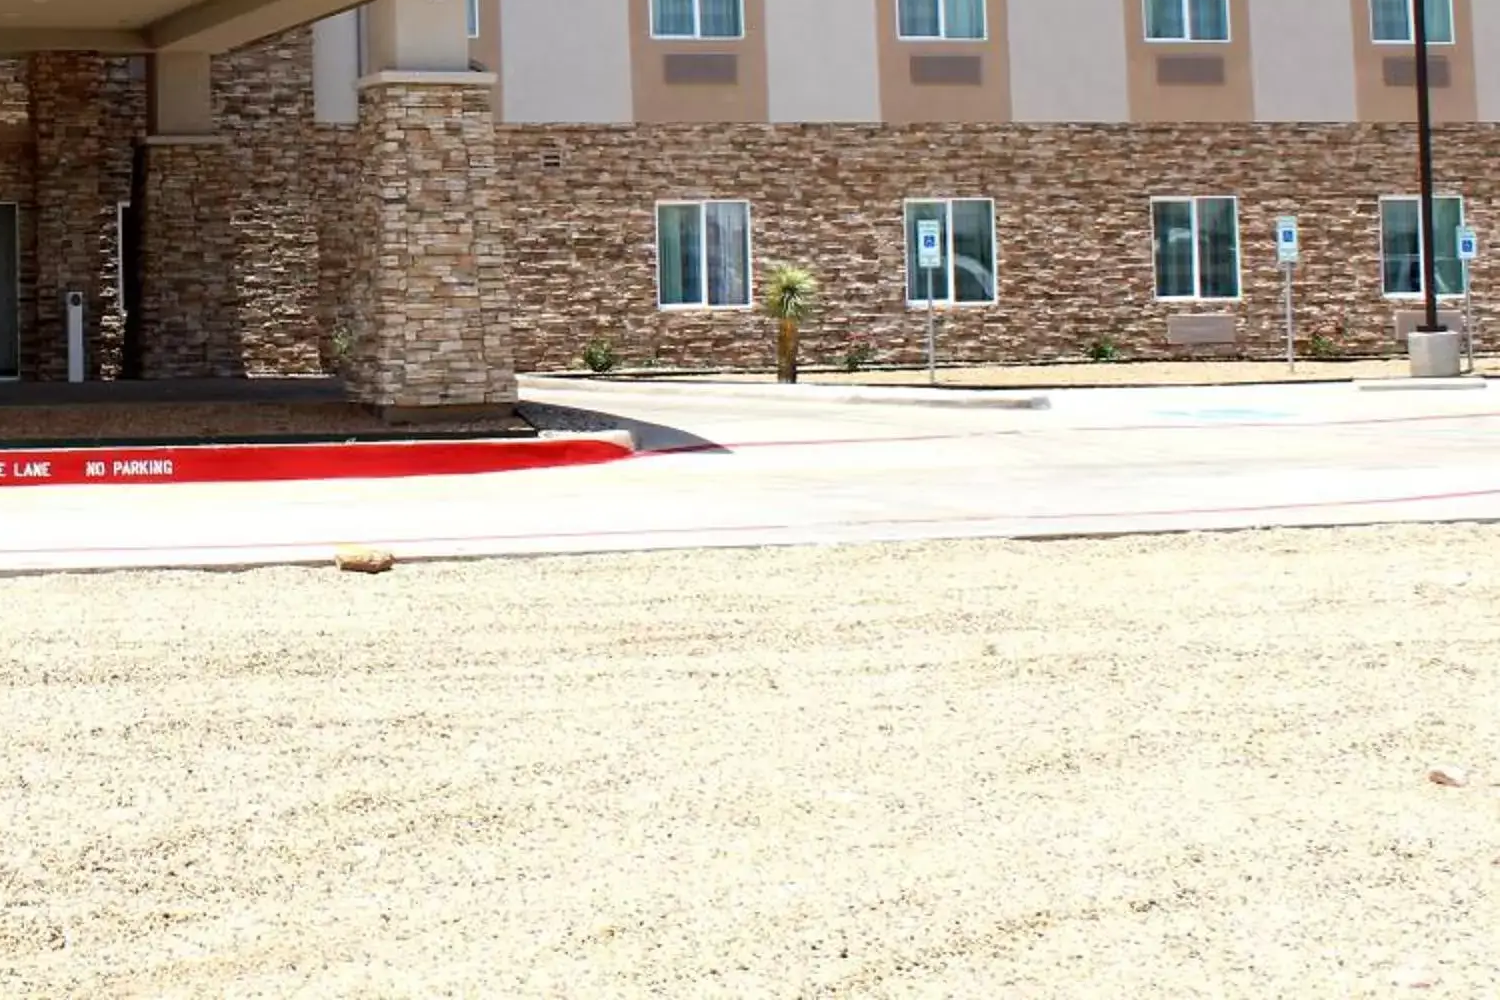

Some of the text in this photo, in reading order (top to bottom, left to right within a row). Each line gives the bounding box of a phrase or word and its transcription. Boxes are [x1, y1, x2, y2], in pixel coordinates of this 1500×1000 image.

[13, 462, 51, 477] LANE
[86, 461, 104, 476] NO
[113, 460, 173, 475] PARKING
